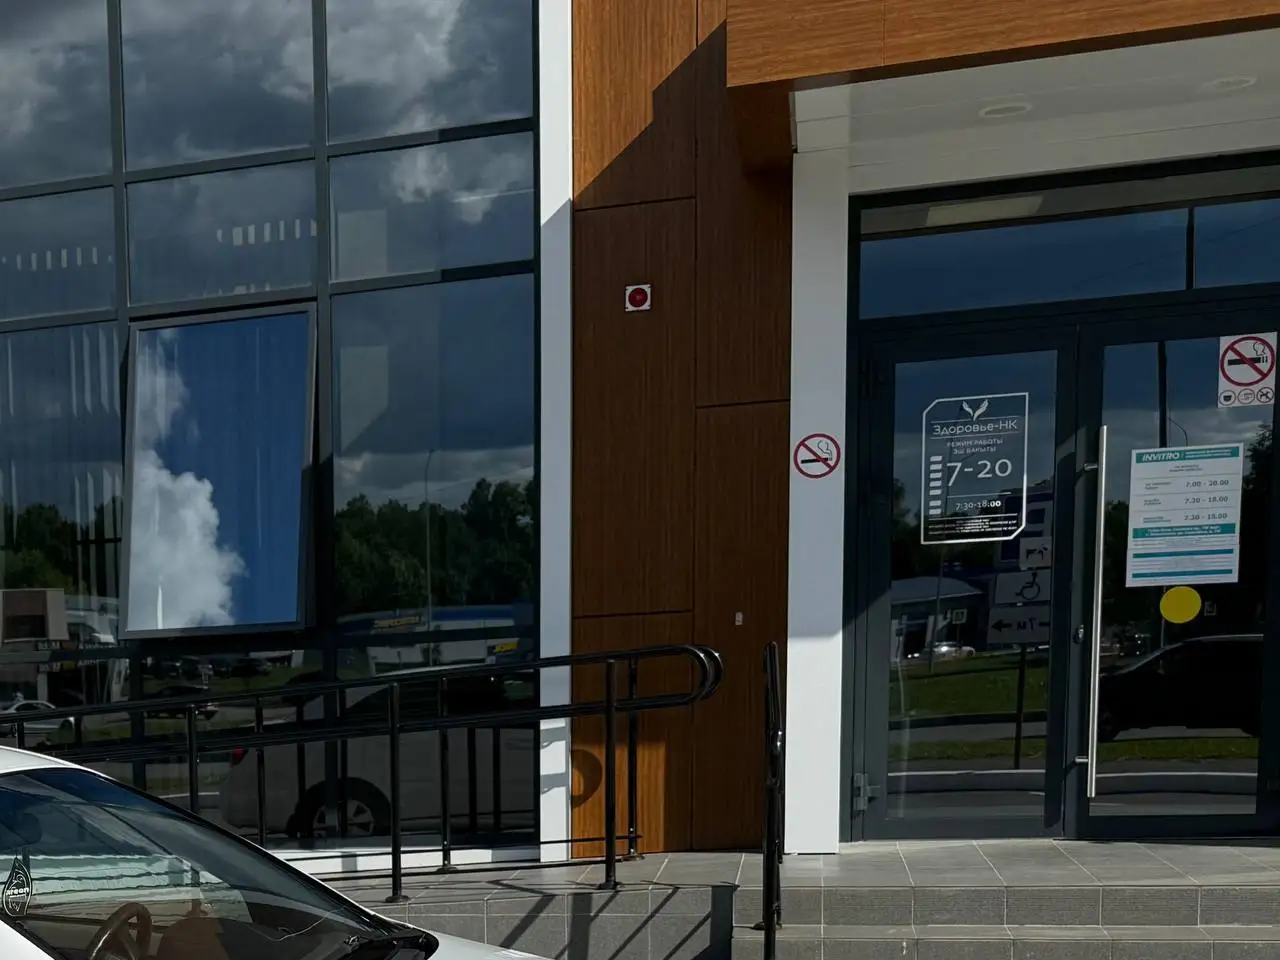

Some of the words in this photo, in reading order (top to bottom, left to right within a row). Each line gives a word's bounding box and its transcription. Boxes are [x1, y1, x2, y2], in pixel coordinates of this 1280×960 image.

[932, 419, 1018, 436] Здоровье-НК
[1142, 451, 1180, 463] INVITRO
[946, 458, 1013, 487] 7-20
